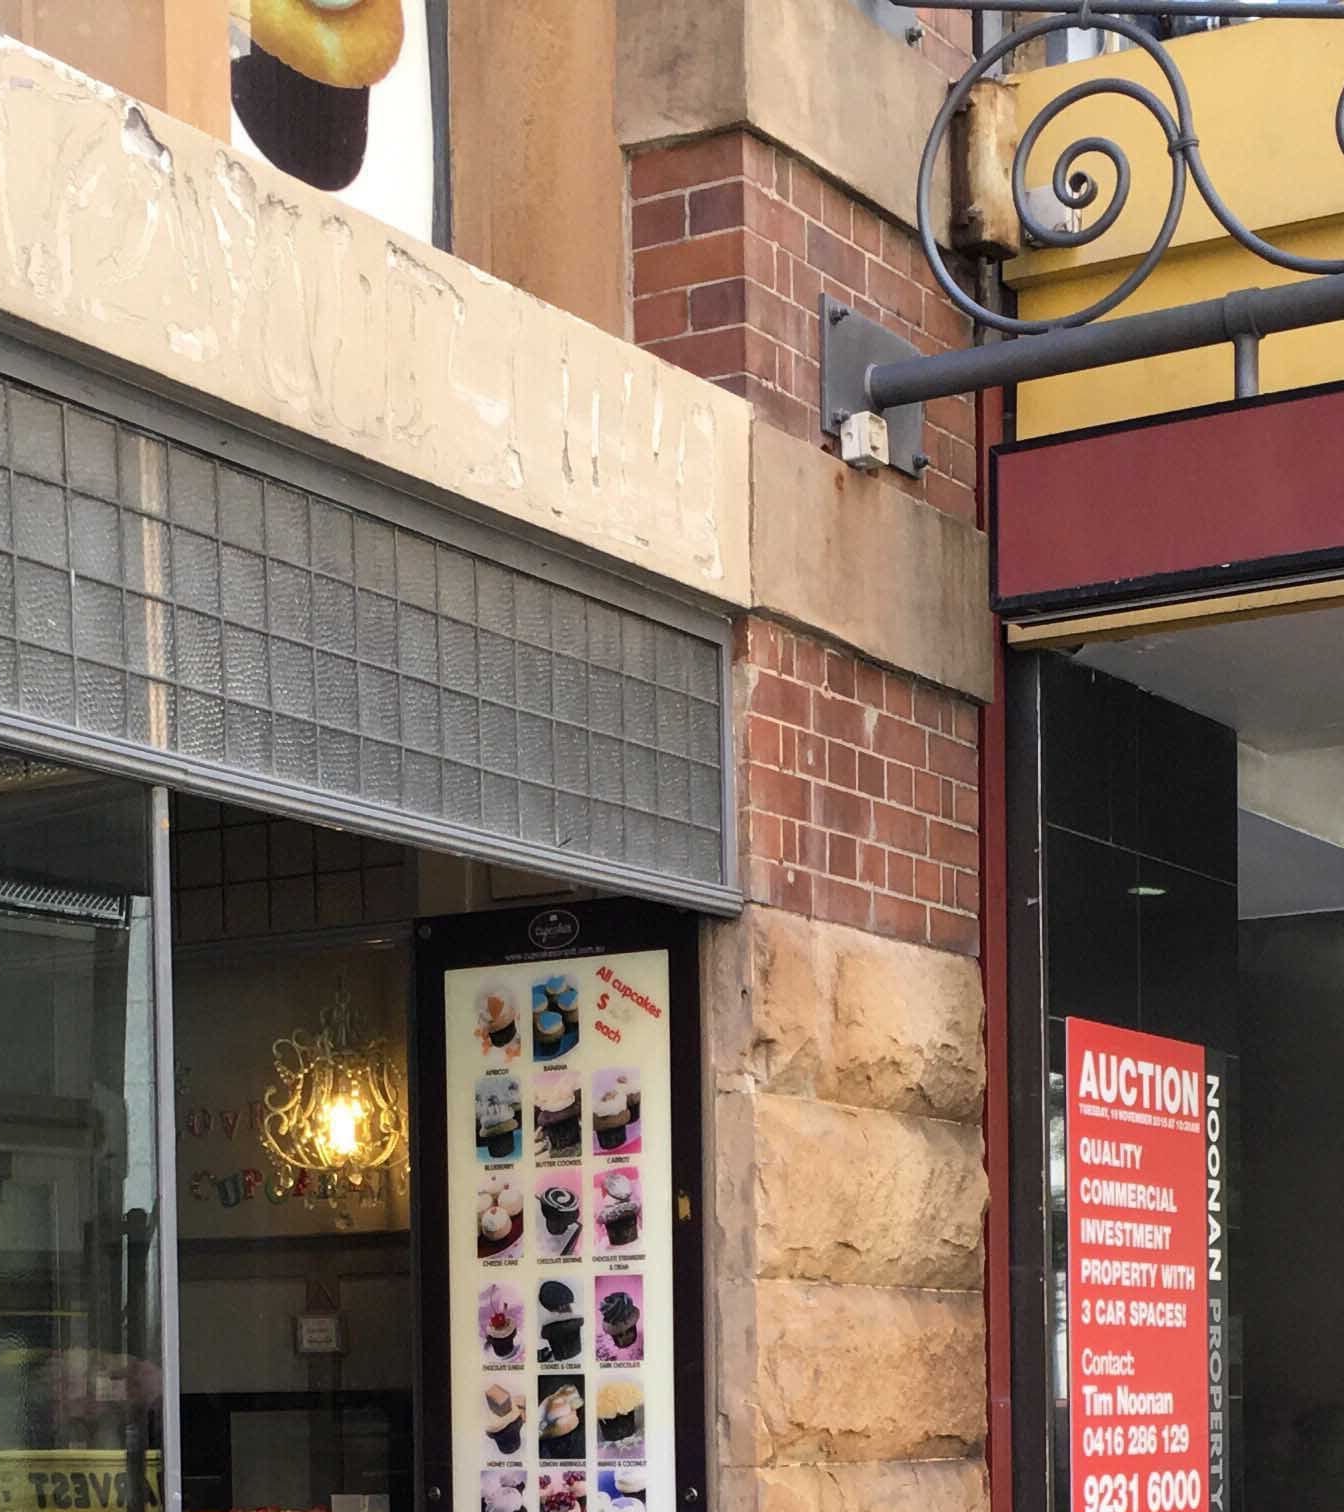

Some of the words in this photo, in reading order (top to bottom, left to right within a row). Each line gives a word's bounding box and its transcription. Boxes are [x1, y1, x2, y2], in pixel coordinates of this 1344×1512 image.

[595, 965, 614, 983] All
[611, 977, 663, 1019] cupcakes
[594, 1019, 622, 1044] each
[1079, 1050, 1199, 1118] AUCTION
[1080, 1137, 1143, 1170] QUALITY
[1206, 1074, 1222, 1283] NOONAN
[1080, 1178, 1178, 1214] COMMERCIAL
[1081, 1218, 1172, 1251] INVESTMENT
[1081, 1257, 1158, 1290] PROPERTY
[1160, 1263, 1196, 1292] WITH
[1081, 1299, 1091, 1326] 3
[1095, 1300, 1127, 1327] CAR
[1129, 1301, 1187, 1329] SPACES!
[1081, 1347, 1135, 1378] Contact:
[1083, 1385, 1113, 1416] Tim
[1116, 1386, 1174, 1417] Noonan
[1207, 1297, 1224, 1512] PROPERTY
[1083, 1425, 1124, 1458] 0416
[1127, 1425, 1158, 1457] 286
[1161, 1424, 1190, 1454] 129
